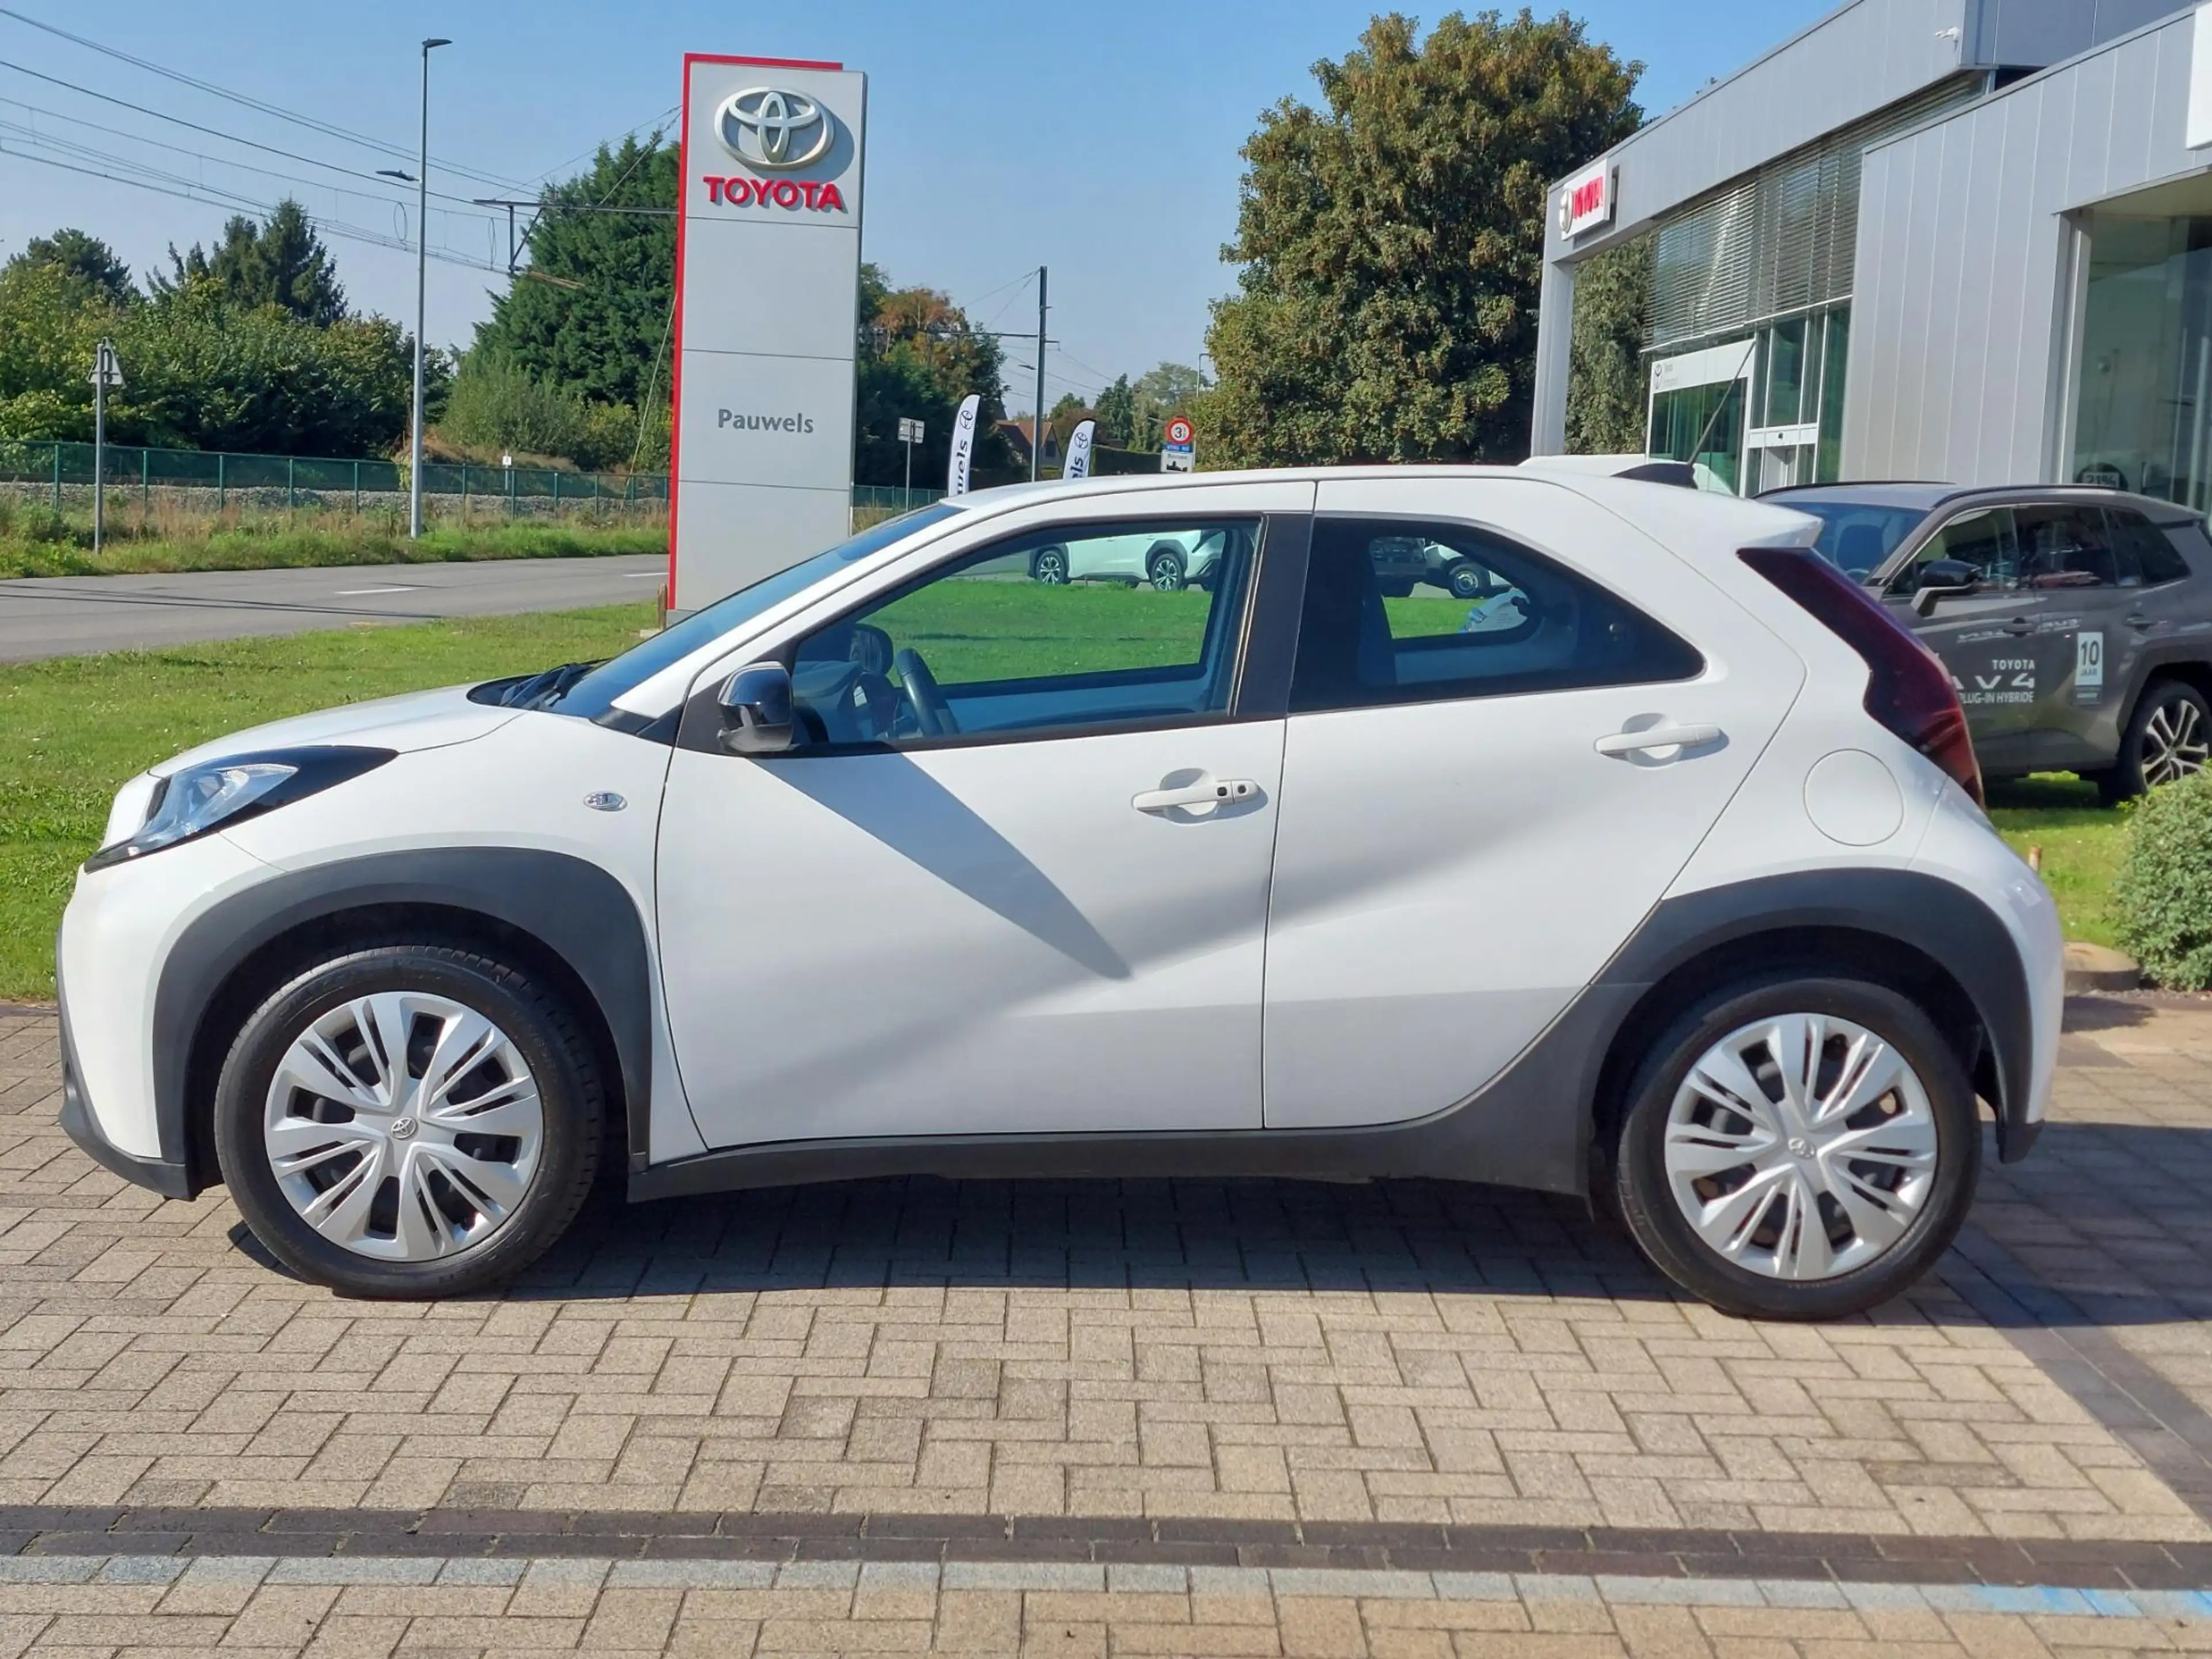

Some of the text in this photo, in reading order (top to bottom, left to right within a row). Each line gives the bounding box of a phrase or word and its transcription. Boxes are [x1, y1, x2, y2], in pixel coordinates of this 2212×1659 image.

[703, 176, 843, 210] TOYOTA
[718, 408, 814, 433] Pauwels
[1991, 659, 2035, 670] TOYOTA
[2081, 639, 2100, 666] 10
[1997, 691, 2035, 703] HYBRIDE
